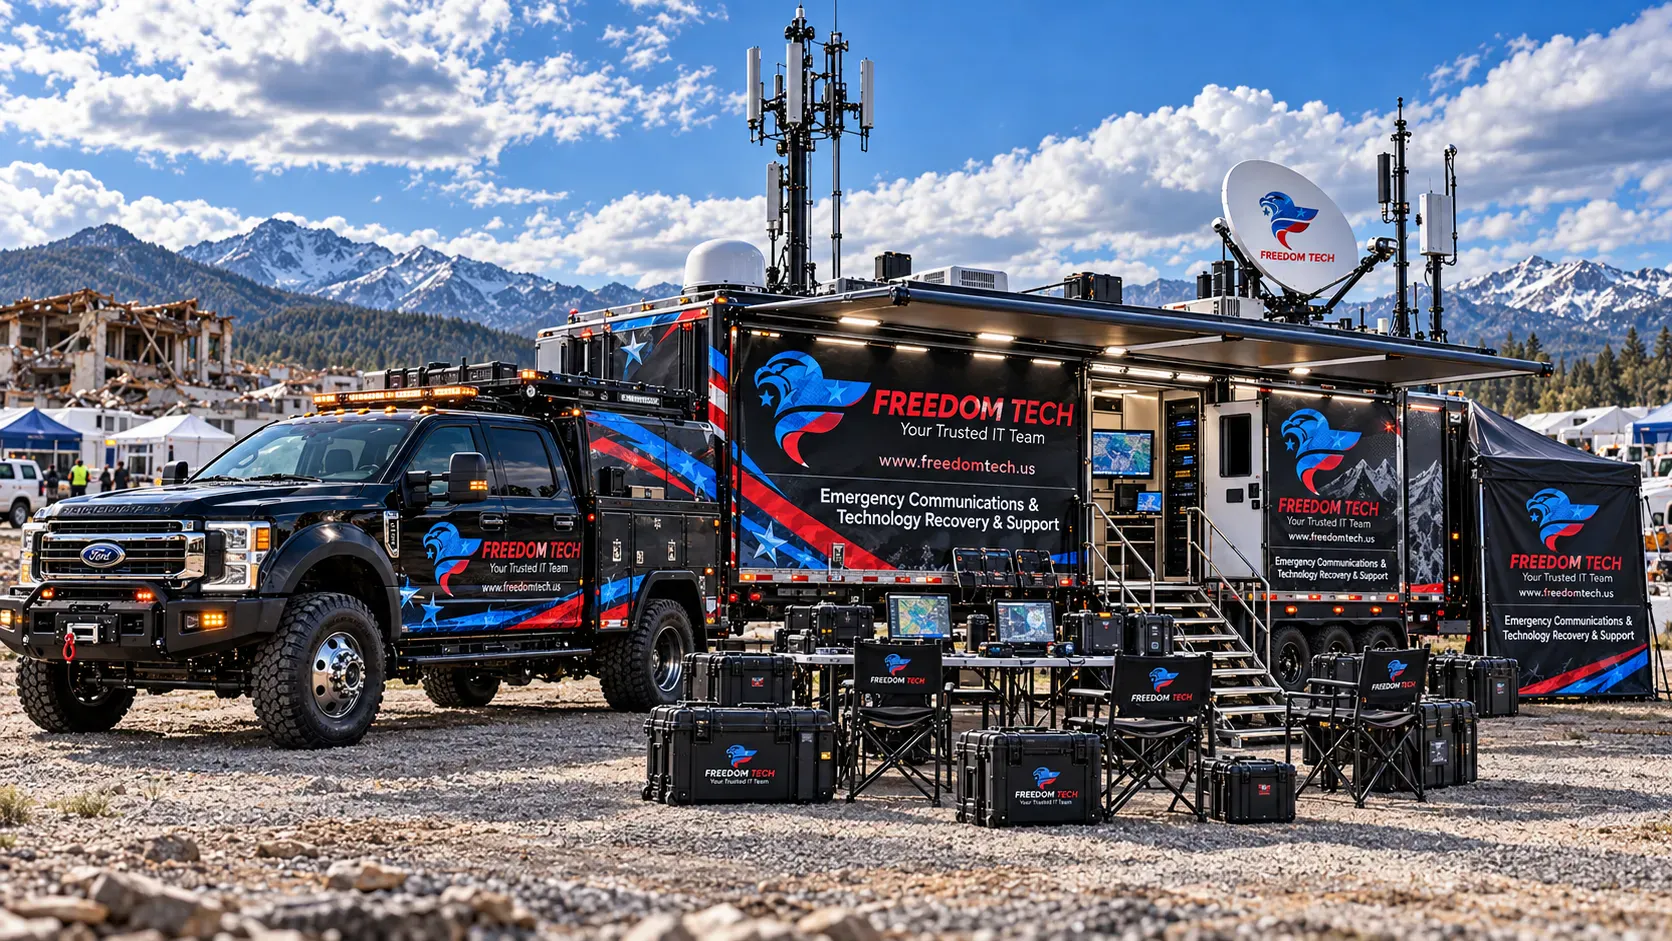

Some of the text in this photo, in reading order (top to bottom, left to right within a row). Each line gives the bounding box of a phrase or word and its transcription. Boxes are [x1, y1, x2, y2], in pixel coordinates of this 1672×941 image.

[1260, 250, 1335, 262] FREEDOM TECH
[872, 389, 1074, 426] FREEDOM TECH
[900, 422, 1045, 444] Your Trusted IT Team
[879, 454, 1035, 476] www.freedomtech.us
[820, 488, 1039, 512] Emergency Communications &
[1278, 497, 1380, 516] FREEDOM TECH
[837, 509, 1059, 534] Technology Recovery & Support
[1286, 516, 1371, 528] Your Trusted IT Team
[1289, 532, 1375, 543] www.freedomtech.us
[88, 549, 110, 561] Ford
[481, 541, 581, 558] FREEDOM TECH
[490, 562, 568, 573] Your Trusted IT Team
[1275, 556, 1386, 568] Emergency Communications &
[1510, 554, 1622, 571] FREEDOM TECH
[1278, 569, 1388, 581] Technology Recovery & Support
[1522, 572, 1613, 582] Your Trusted IT Team
[482, 581, 561, 592] www.freedomtech.us
[1519, 588, 1614, 598] www.freedomtech.us
[1504, 615, 1632, 628] Emergency Communications &
[1503, 630, 1635, 642] Technology Recovery & Support
[870, 676, 905, 684] FREEDOM
[1131, 693, 1193, 702] FREEDOM TECH
[705, 769, 775, 777] FREEDOM TECH
